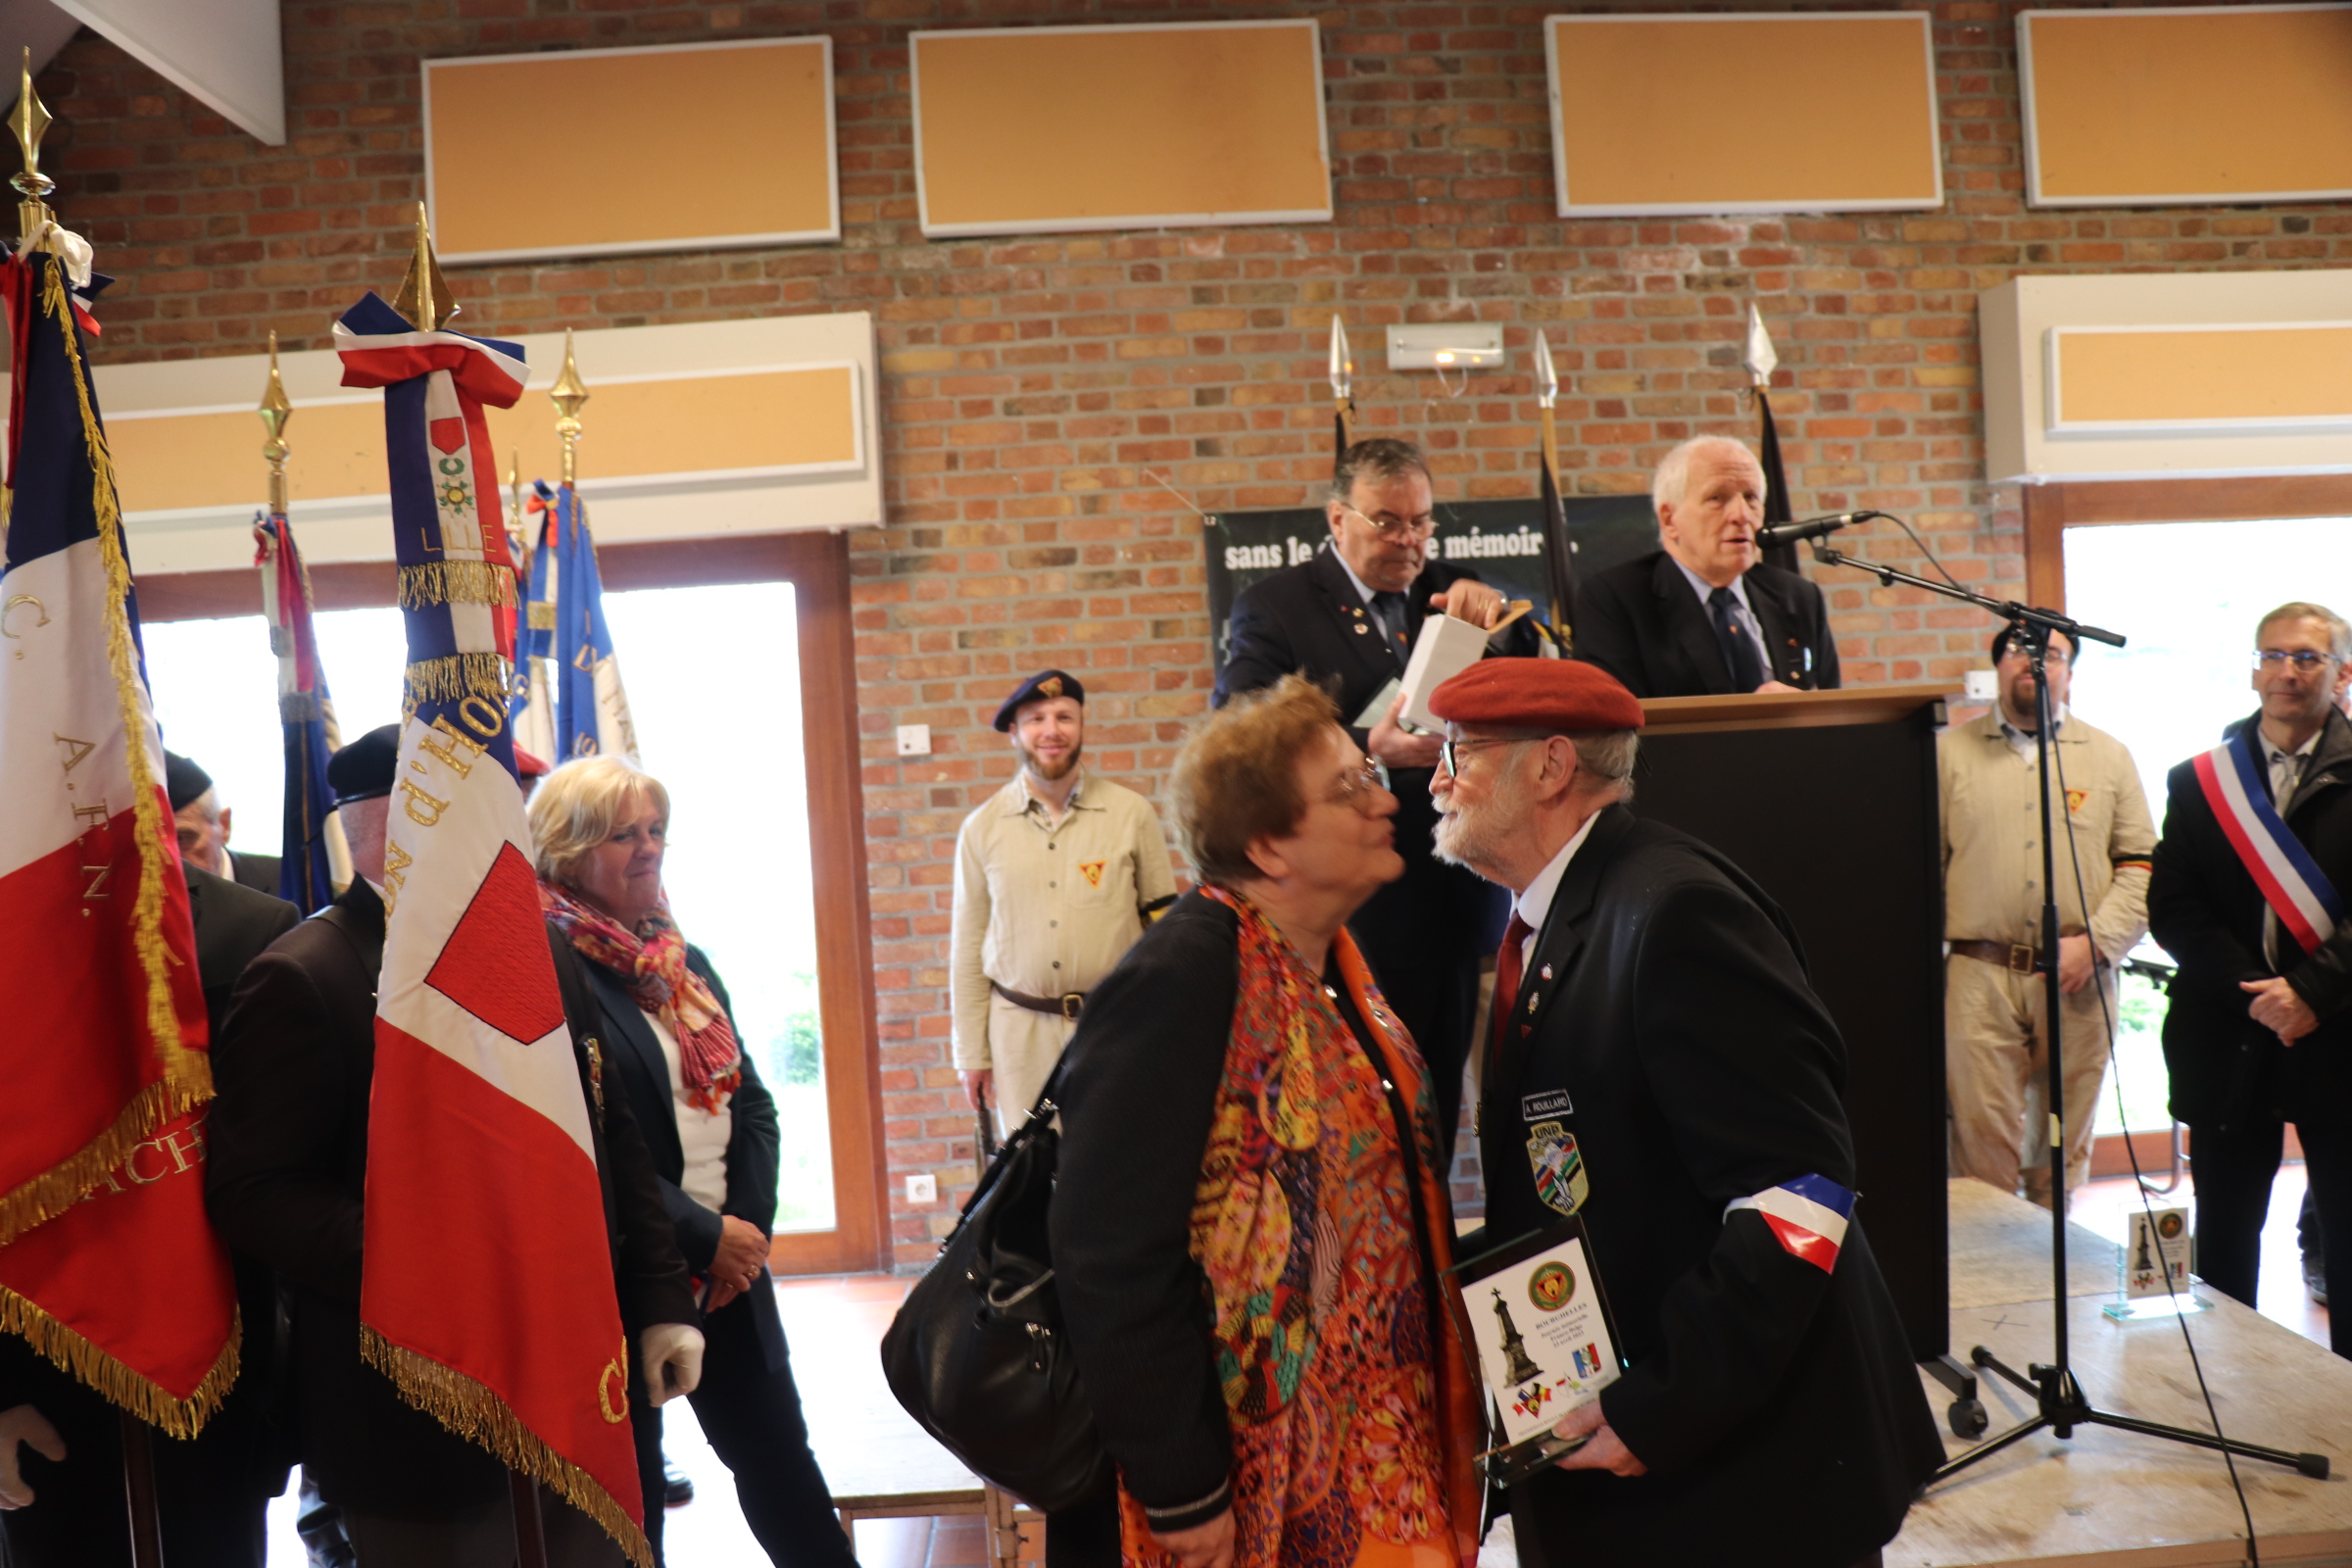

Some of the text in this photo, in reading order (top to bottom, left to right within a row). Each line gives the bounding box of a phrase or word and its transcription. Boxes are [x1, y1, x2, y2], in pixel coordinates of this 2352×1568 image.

[421, 524, 497, 553] LILLE
[1224, 543, 1283, 570] sans
[1286, 535, 1313, 567] le
[1444, 524, 1545, 560] mémoir
